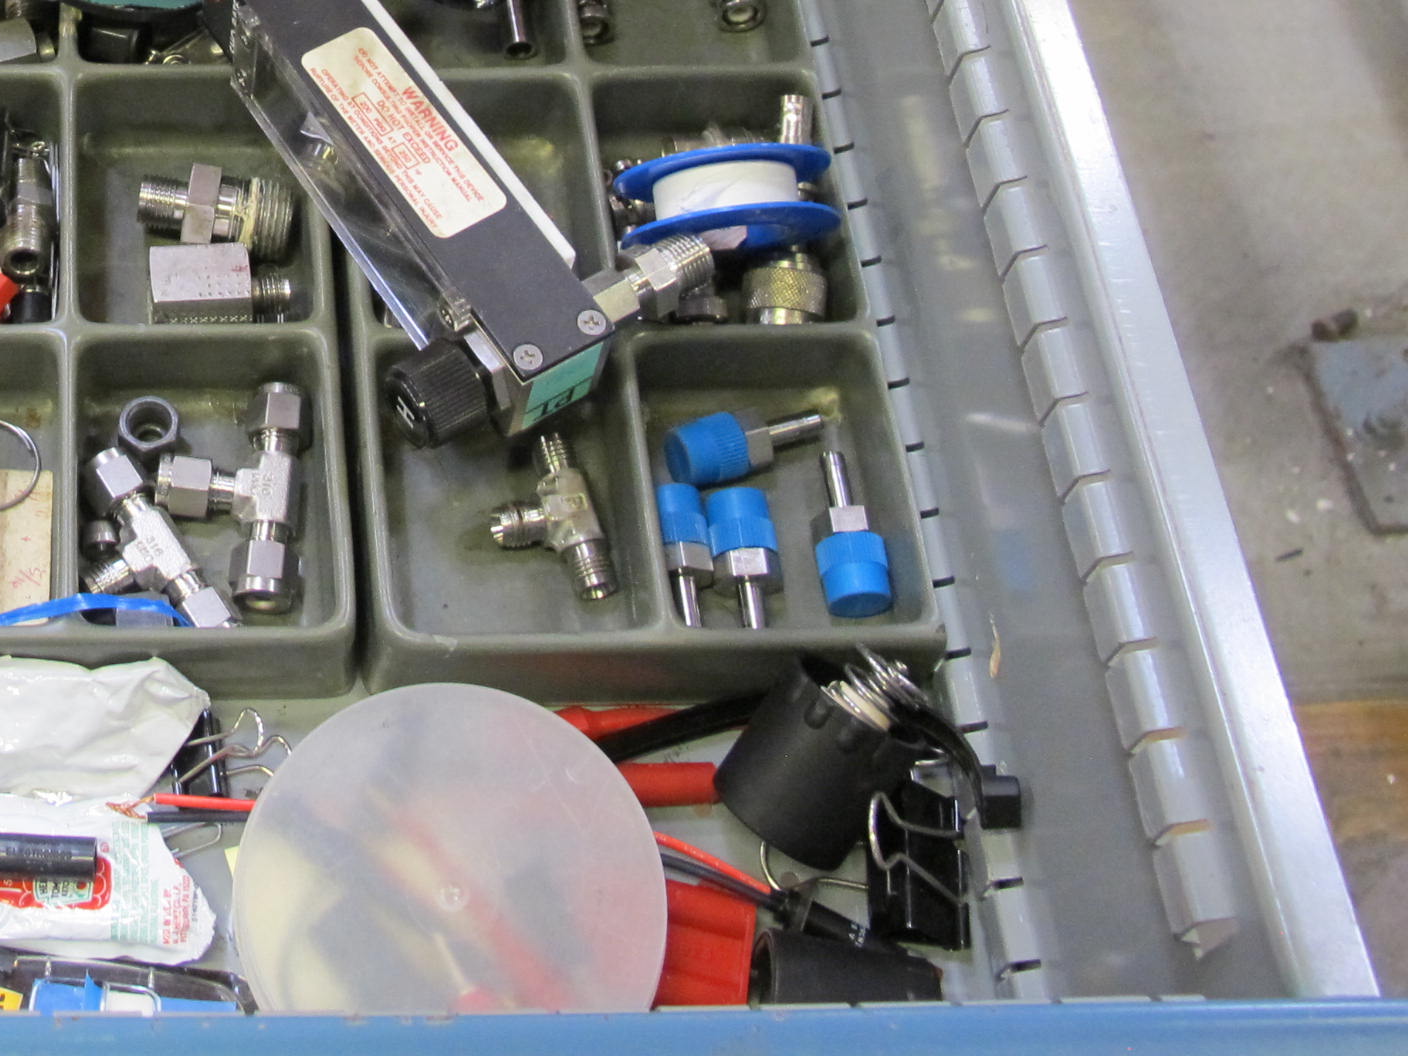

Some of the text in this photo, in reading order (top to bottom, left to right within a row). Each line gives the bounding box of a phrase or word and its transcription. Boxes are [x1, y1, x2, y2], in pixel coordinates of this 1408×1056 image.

[375, 98, 432, 165] DO NOT EXCEED
[399, 85, 461, 152] WARNING
